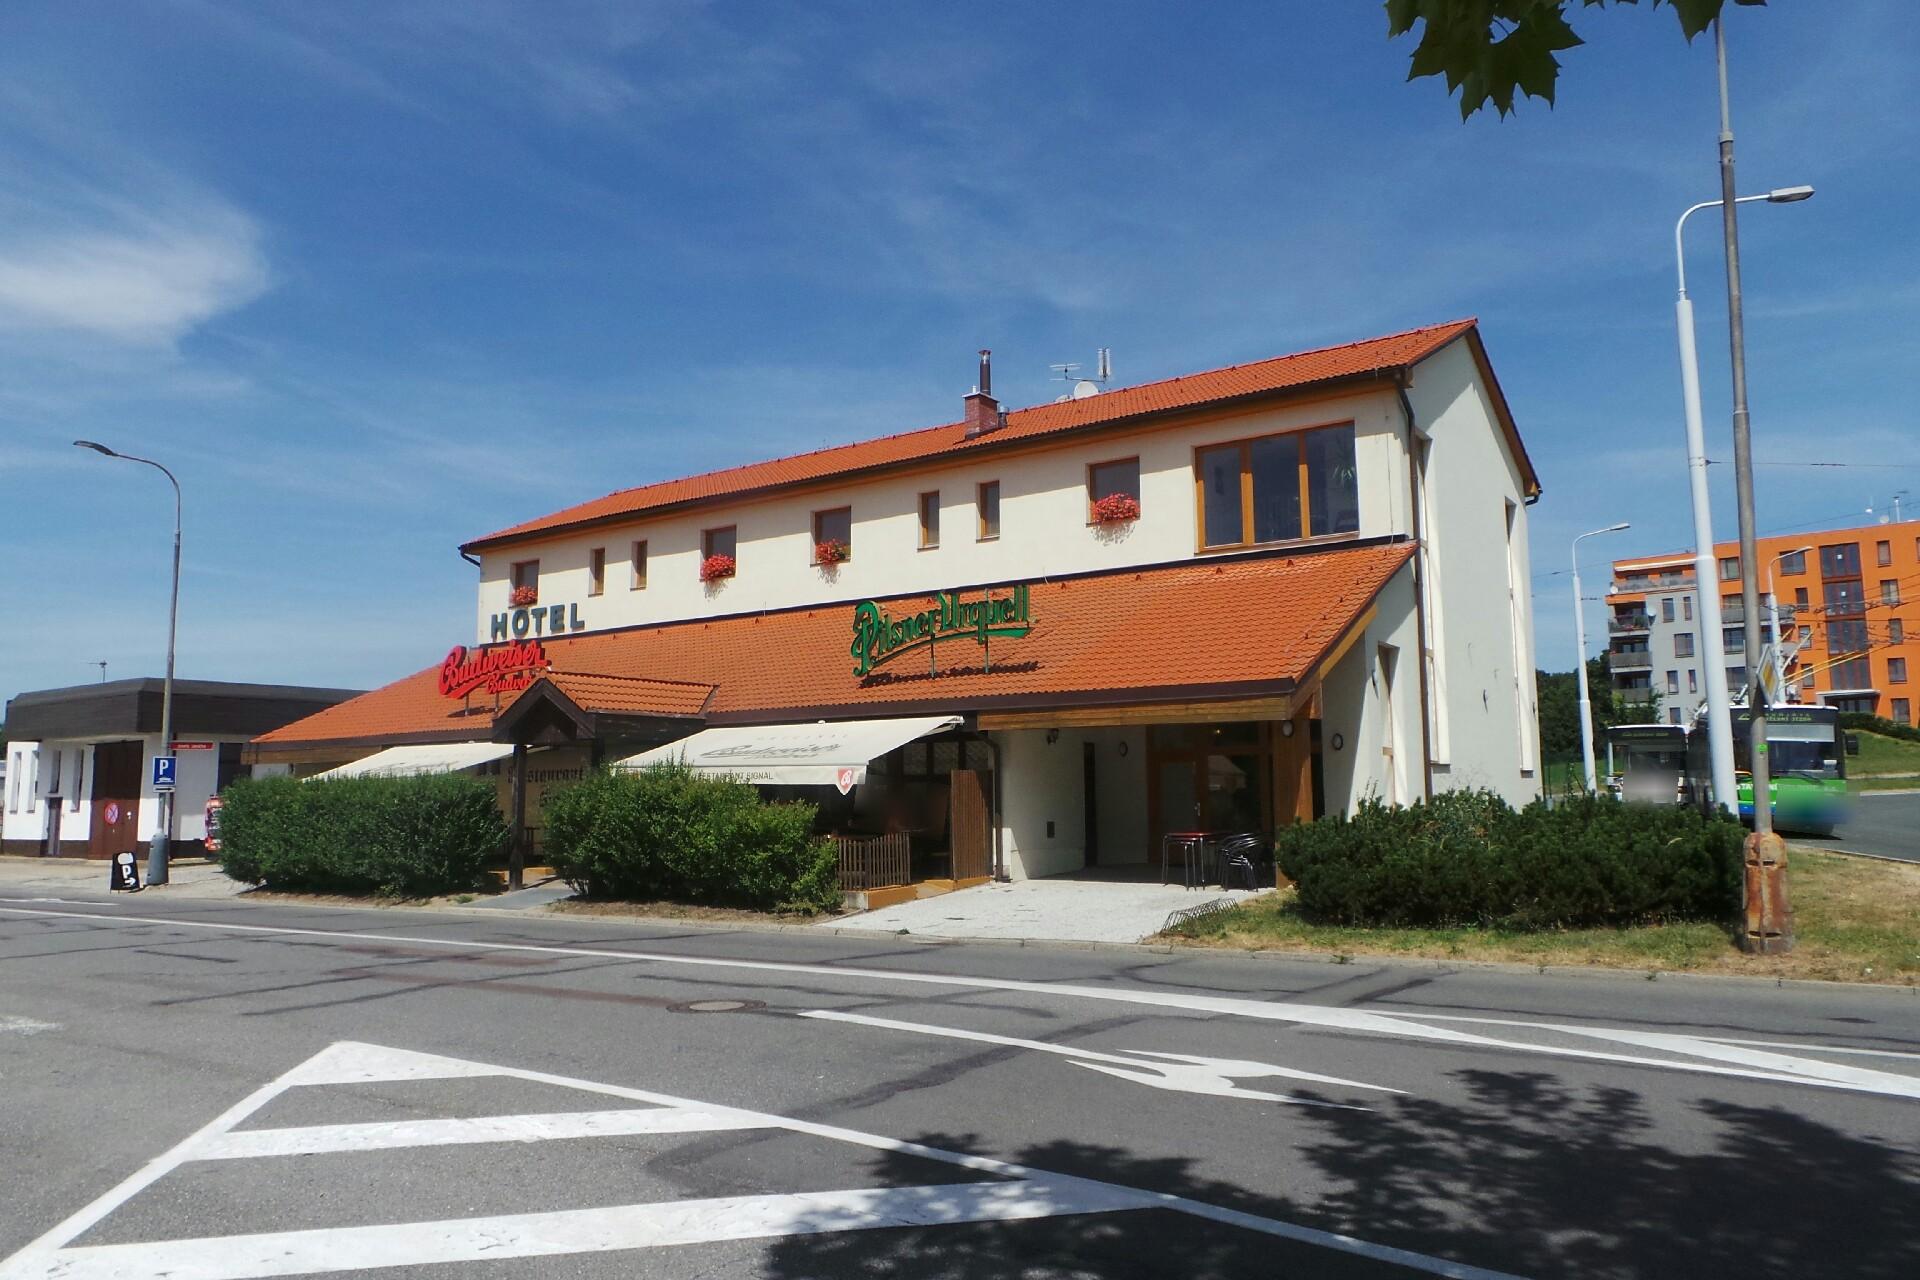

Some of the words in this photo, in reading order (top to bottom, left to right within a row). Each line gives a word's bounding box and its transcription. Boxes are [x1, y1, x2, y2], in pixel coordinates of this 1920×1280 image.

[491, 603, 585, 642] HOTEL
[851, 601, 942, 677] Pilsner
[936, 585, 1031, 645] Urquell
[438, 639, 551, 700] Budweiser
[159, 759, 169, 776] P
[746, 772, 774, 780] SIGNAL
[122, 864, 132, 879] P
